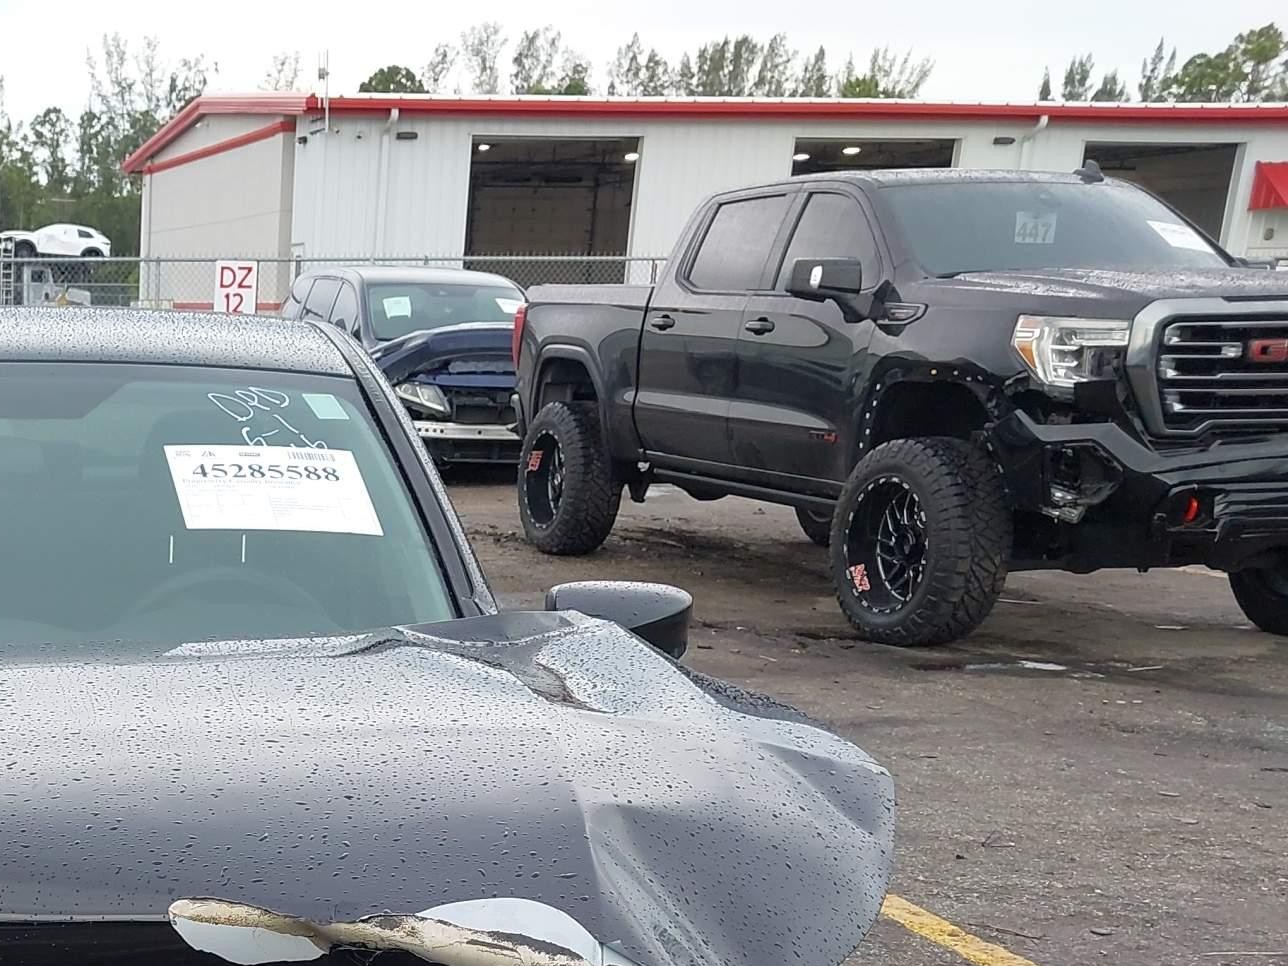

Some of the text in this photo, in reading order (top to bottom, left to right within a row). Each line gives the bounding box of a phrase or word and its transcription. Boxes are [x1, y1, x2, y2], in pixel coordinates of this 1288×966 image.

[219, 266, 253, 288] DZ
[223, 292, 244, 314] 12
[192, 463, 341, 482] 45285588
